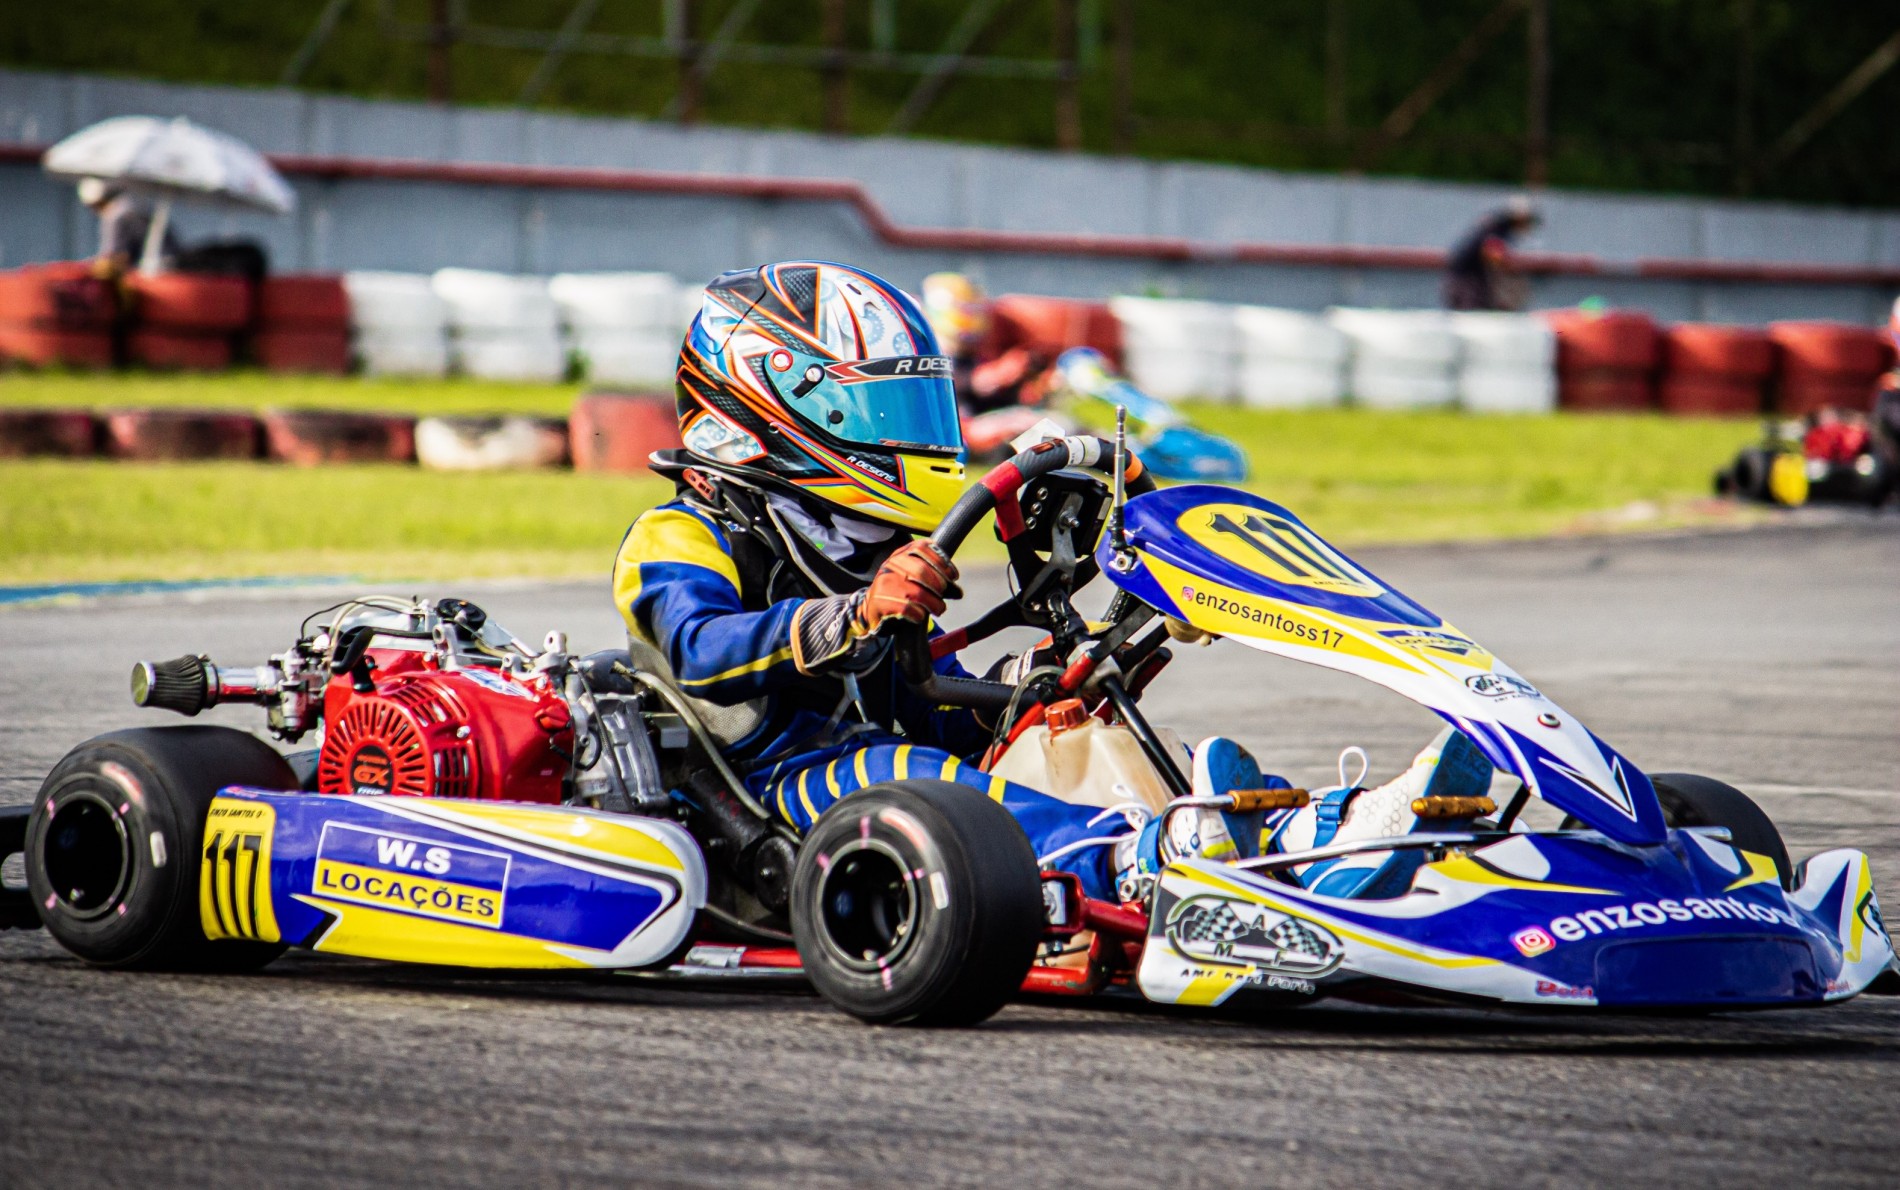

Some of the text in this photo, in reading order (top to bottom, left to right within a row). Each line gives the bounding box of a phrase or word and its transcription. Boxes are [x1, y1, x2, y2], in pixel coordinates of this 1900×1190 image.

[846, 455, 897, 482] R DESIGNS
[1208, 513, 1366, 586] 117
[1195, 591, 1345, 648] enzosantoss17
[353, 764, 390, 786] GX
[377, 836, 452, 875] W.S
[204, 831, 263, 937] 117
[321, 868, 495, 918] LOCAÇÕES
